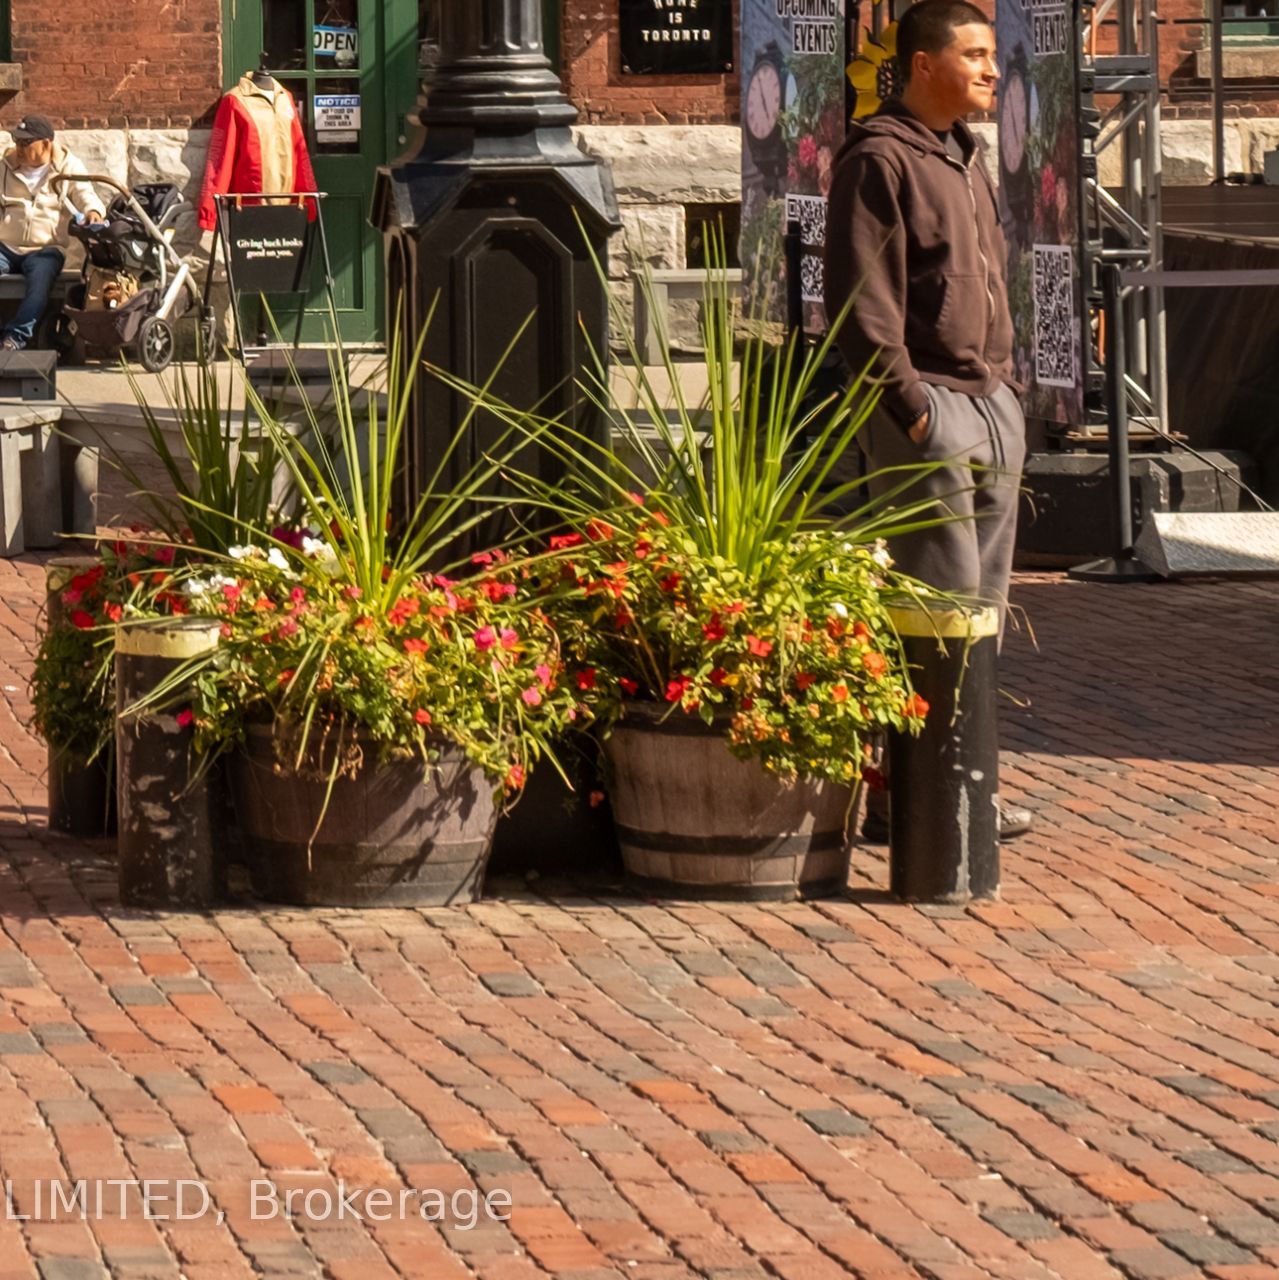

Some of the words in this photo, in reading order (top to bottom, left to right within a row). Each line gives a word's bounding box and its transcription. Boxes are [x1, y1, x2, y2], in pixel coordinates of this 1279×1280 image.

[669, 12, 683, 24] IS
[314, 31, 356, 51] OPEN
[641, 29, 711, 42] TORONTO
[794, 24, 836, 53] EVENTS
[1034, 11, 1066, 55] EVENTS
[317, 98, 358, 106] NOTICE
